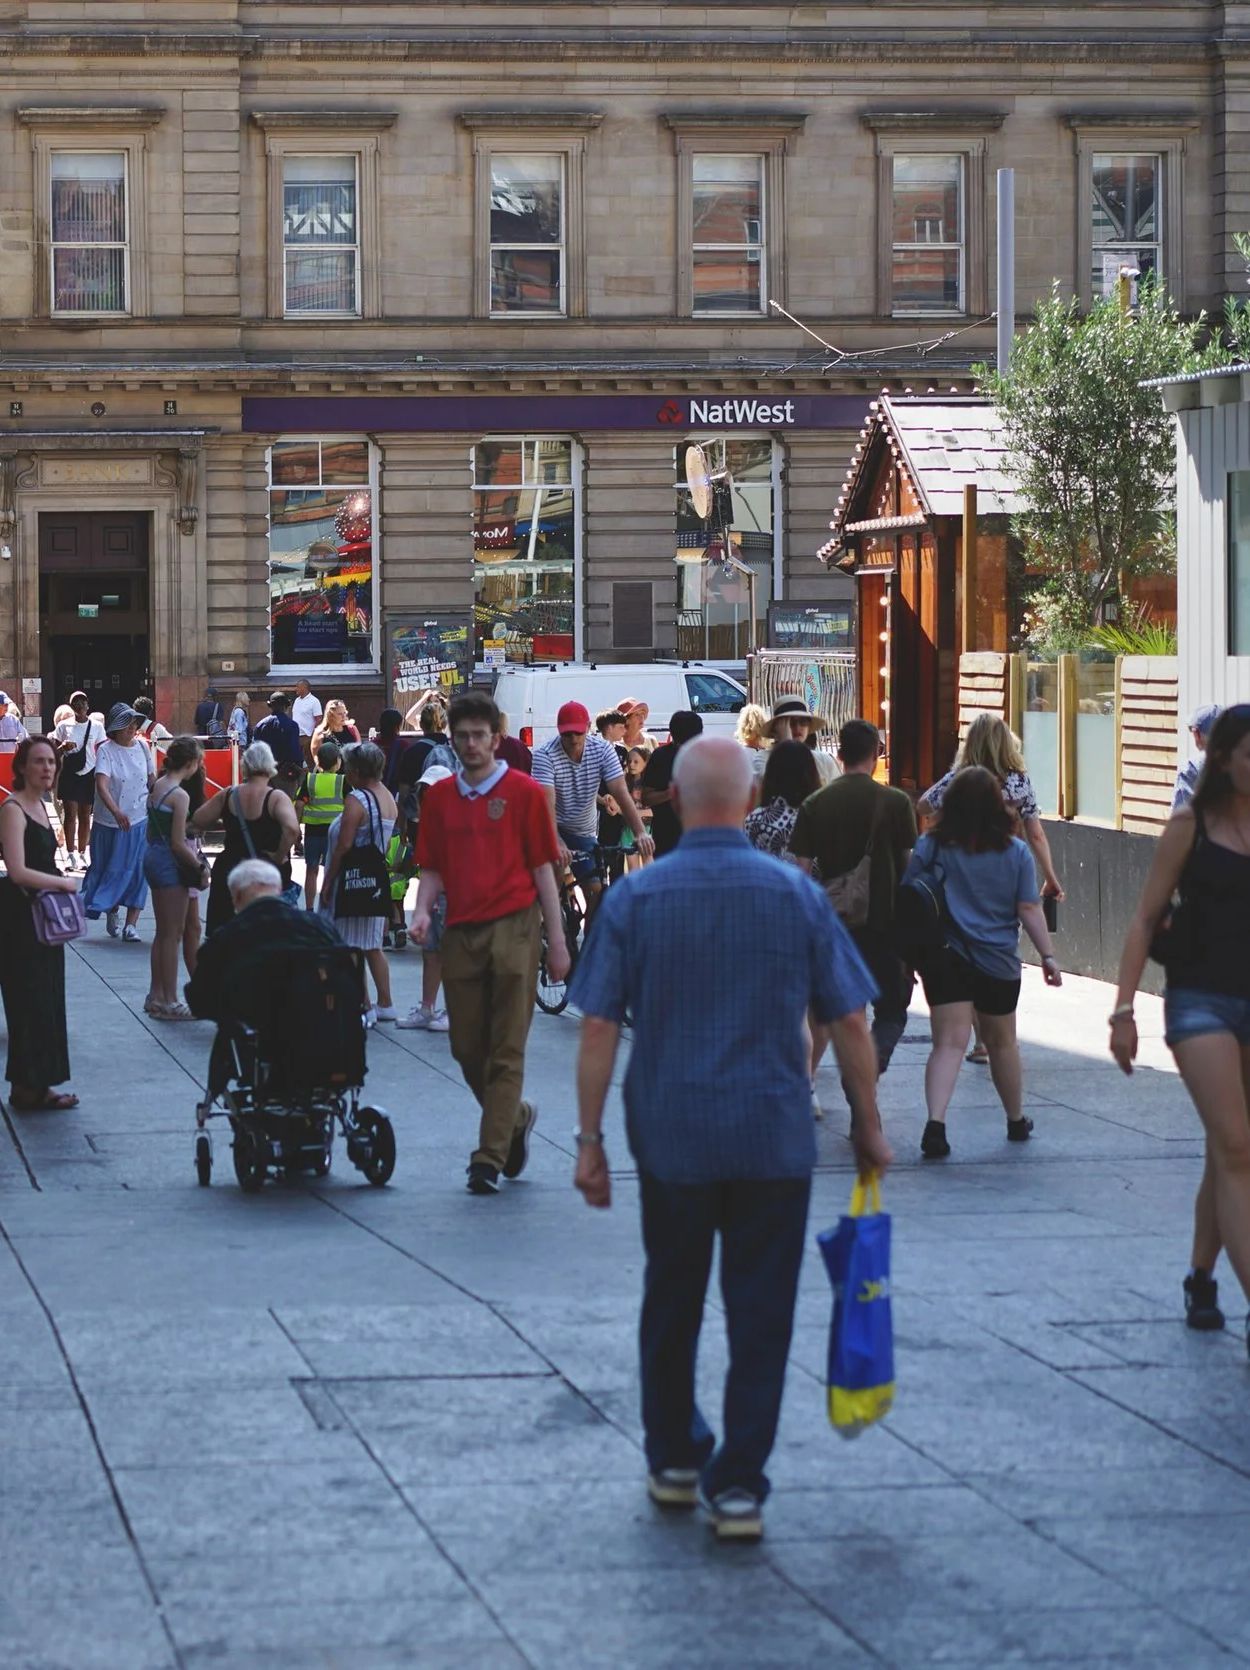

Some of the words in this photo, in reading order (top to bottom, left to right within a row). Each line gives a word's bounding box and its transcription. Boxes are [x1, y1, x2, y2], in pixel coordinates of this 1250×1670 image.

[690, 400, 795, 423] NatWest
[65, 463, 130, 481] BANK
[399, 660, 416, 669] THE
[417, 657, 439, 666] REAL
[400, 665, 429, 676] WORLD
[430, 661, 457, 672] NEEDS
[394, 669, 464, 693] USEFUL
[345, 868, 360, 879] KATE
[345, 877, 376, 890] ATKINSON
